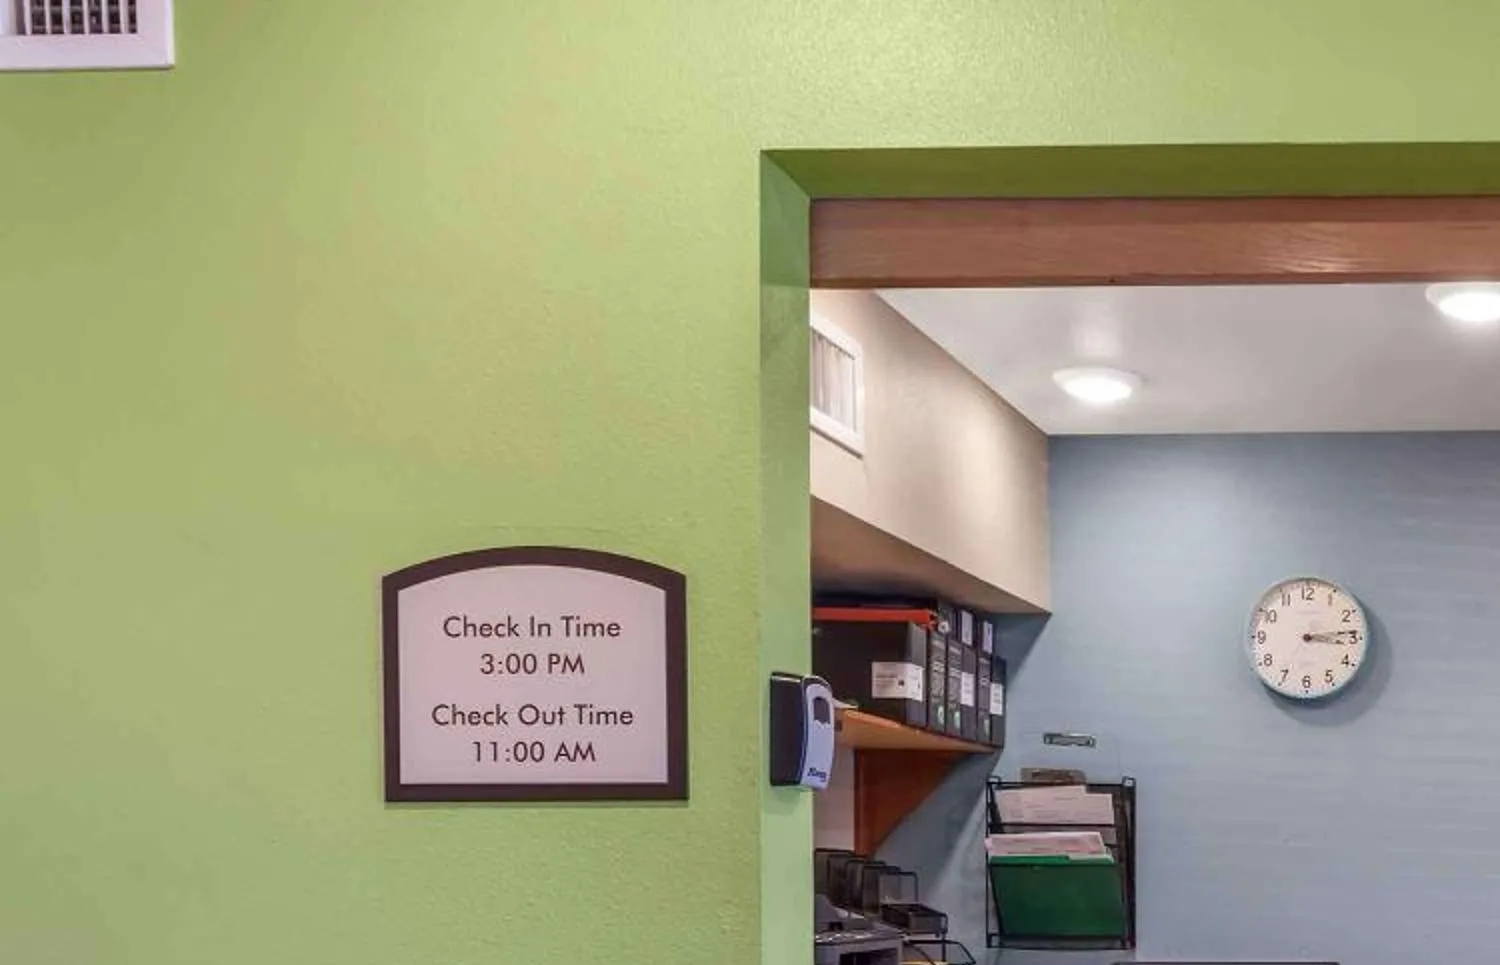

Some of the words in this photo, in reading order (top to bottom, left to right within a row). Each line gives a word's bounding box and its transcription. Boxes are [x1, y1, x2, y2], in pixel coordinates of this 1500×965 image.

[1281, 593, 1291, 606] 11
[1301, 587, 1315, 601] 12
[1264, 609, 1278, 623] 10
[1341, 609, 1352, 623] 2
[442, 614, 521, 639] Check
[529, 615, 552, 638] In
[559, 615, 622, 638] Time
[1257, 630, 1267, 645] 9
[1348, 629, 1359, 645] 3
[479, 652, 538, 675] 3:00
[547, 652, 585, 675] PM
[1263, 653, 1273, 667] 8
[1341, 654, 1350, 667] 4
[1280, 668, 1289, 683] 7
[1302, 676, 1311, 688] 6
[1324, 669, 1334, 683] 5
[431, 703, 509, 727] Check
[517, 703, 567, 726] Out
[573, 703, 634, 726] Time
[472, 740, 545, 764] 11:00
[553, 741, 597, 763] AM
